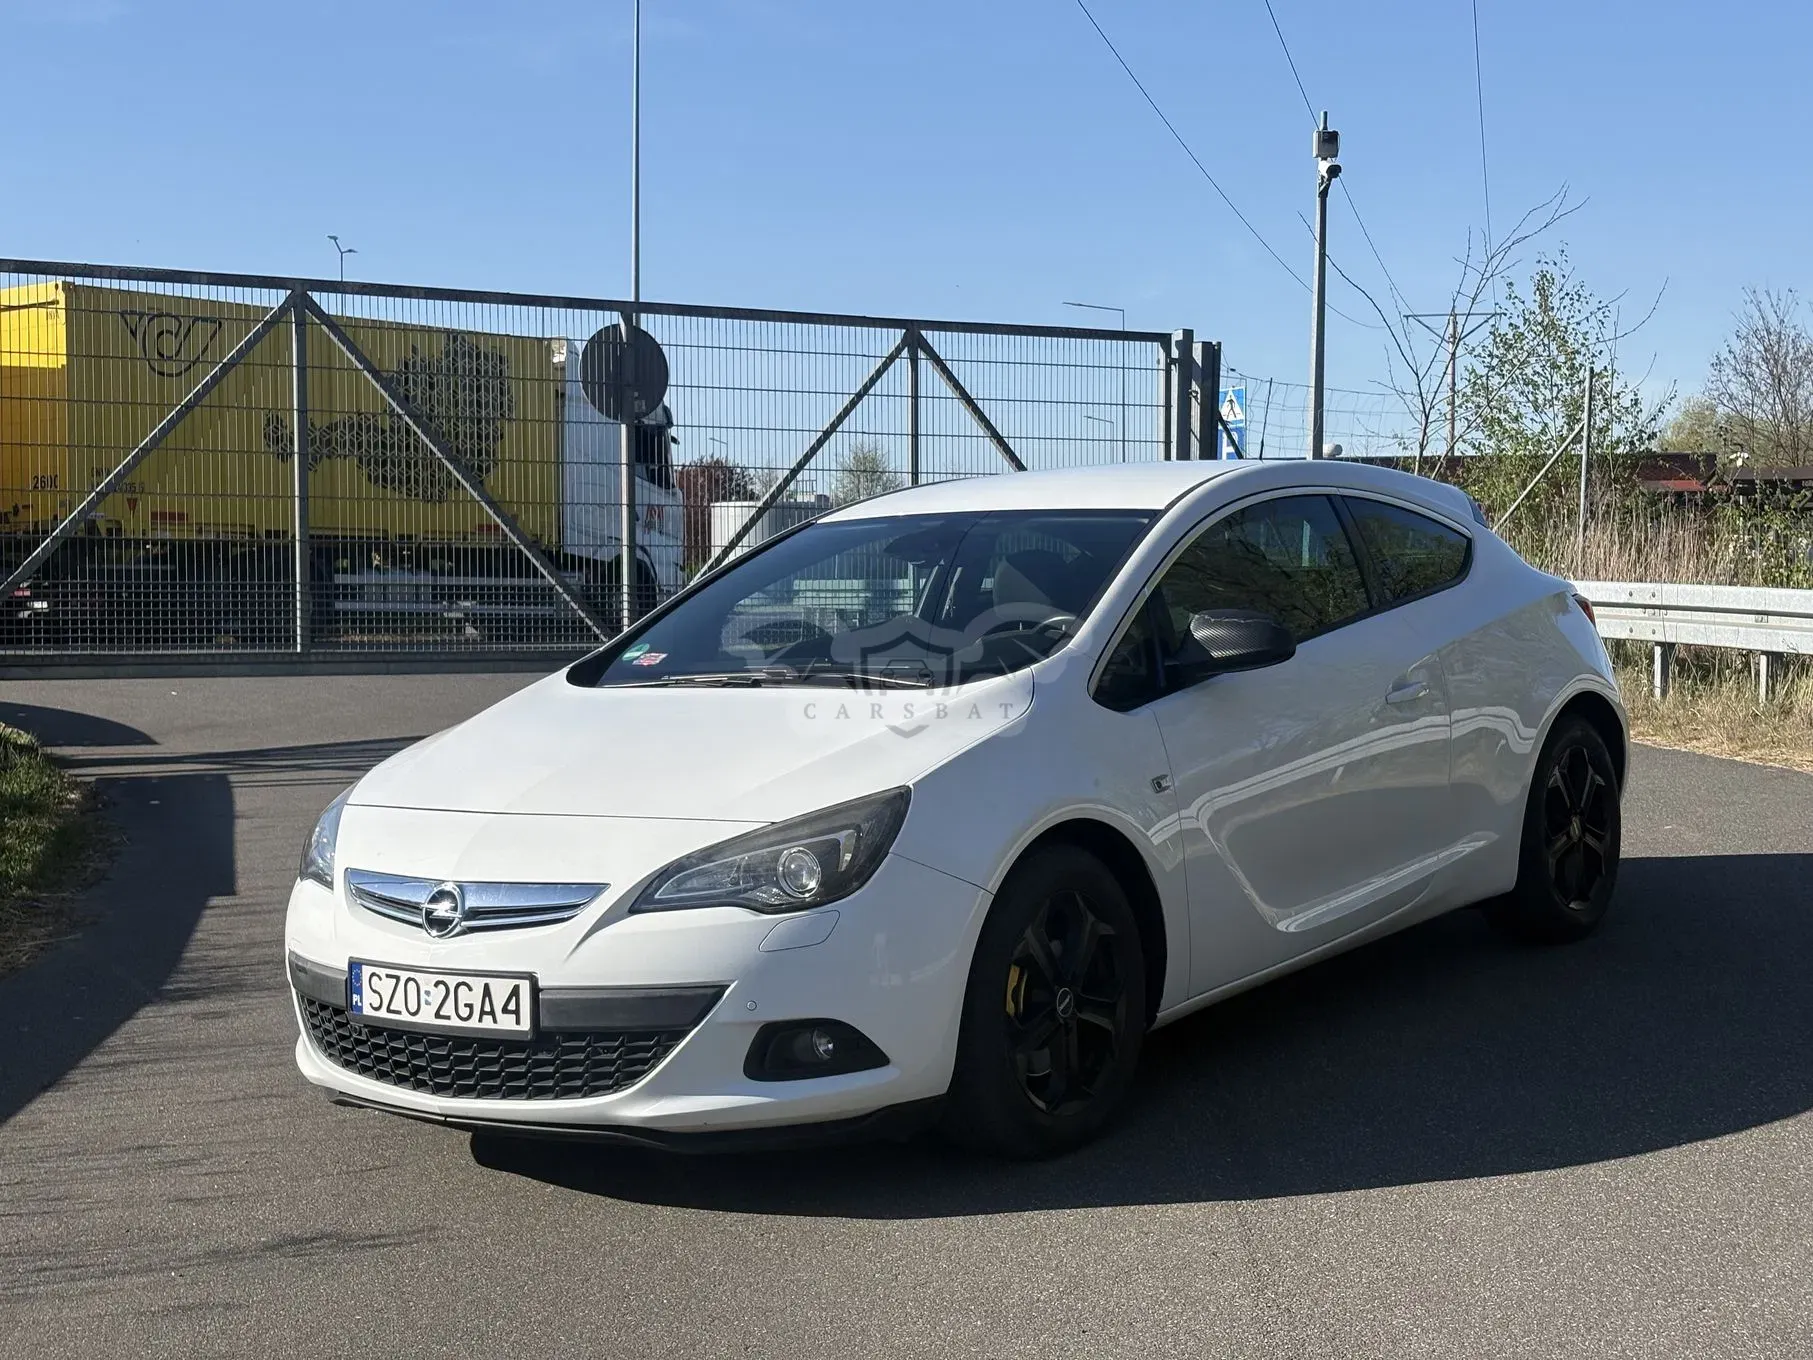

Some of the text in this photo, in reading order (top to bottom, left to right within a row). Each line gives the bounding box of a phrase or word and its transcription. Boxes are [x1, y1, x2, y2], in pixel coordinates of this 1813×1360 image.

[352, 994, 362, 1006] PL
[369, 971, 521, 1026] SZO 2GA4
